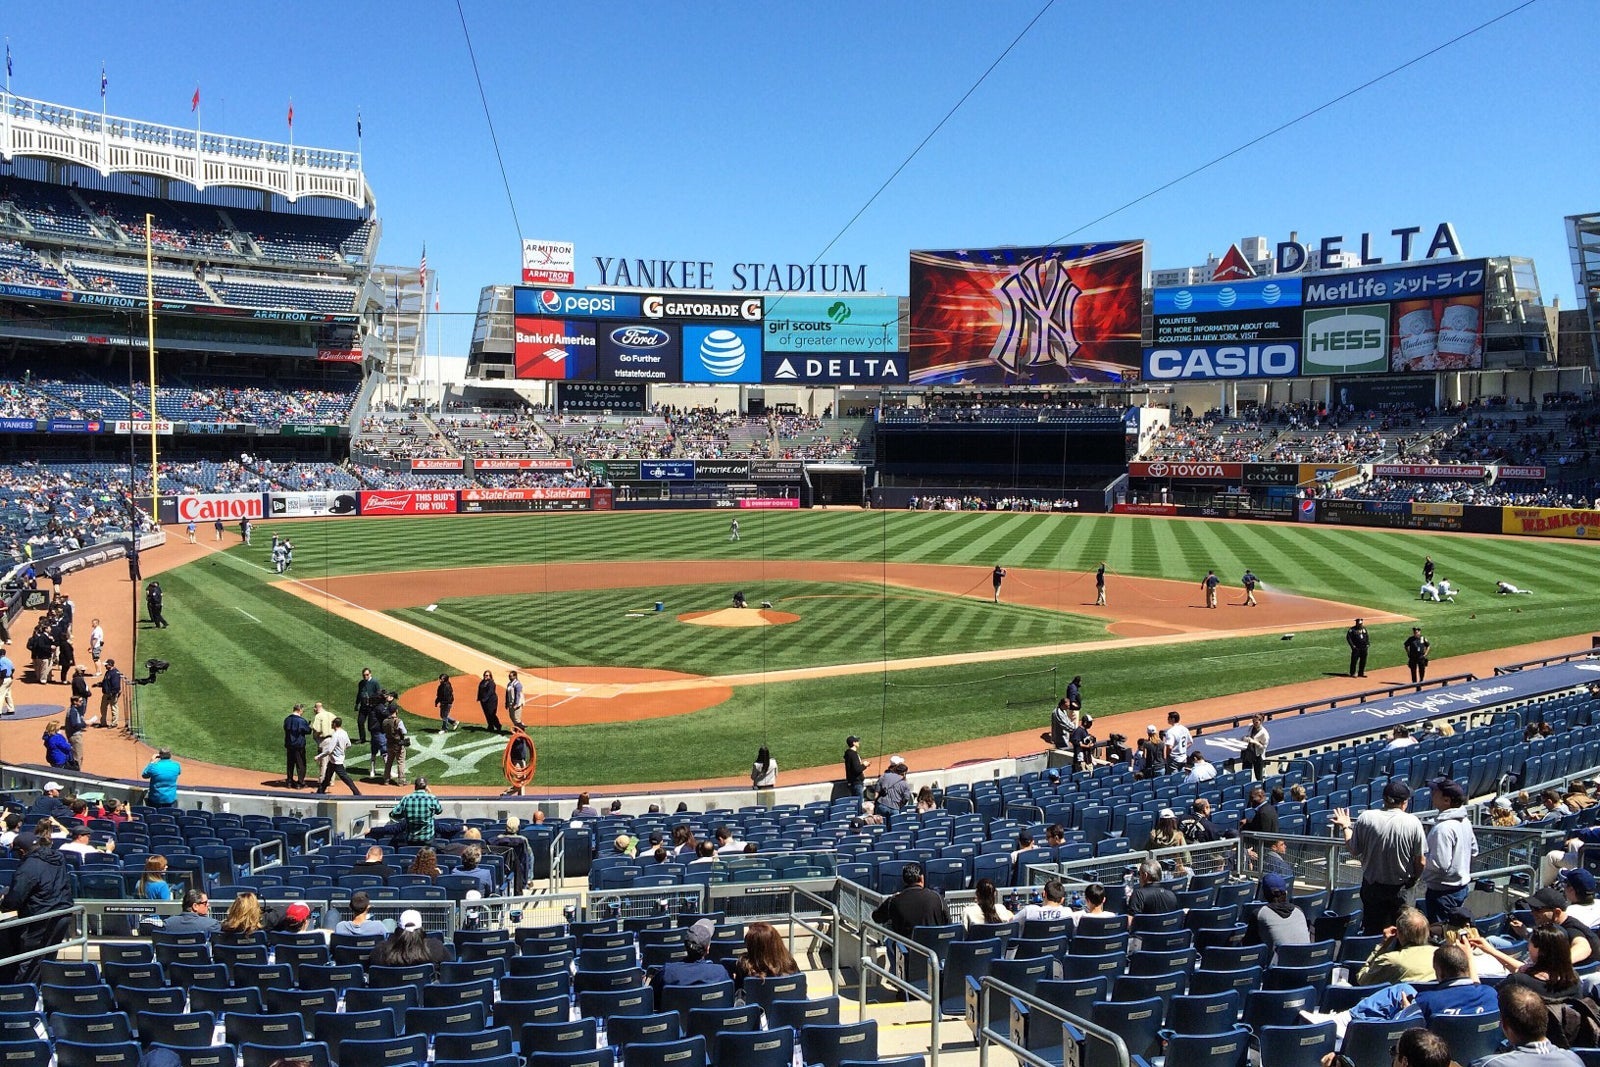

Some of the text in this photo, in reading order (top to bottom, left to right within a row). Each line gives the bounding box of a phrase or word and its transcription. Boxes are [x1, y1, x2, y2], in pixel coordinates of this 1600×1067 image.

[525, 244, 571, 254] ARMITRON
[1276, 222, 1465, 274] DELTA
[528, 270, 570, 280] ARMITRON
[592, 256, 868, 293] YANKEE STADIUM
[1393, 270, 1484, 295] メットライフ
[7, 286, 41, 297] YANKEES
[1306, 277, 1387, 303] MetLife
[79, 294, 135, 307] ARMITRON
[565, 295, 616, 314] pepsi
[254, 310, 307, 321] ARMITRON
[665, 303, 739, 317] GATORADE
[769, 318, 832, 334] girl scouts
[1159, 321, 1281, 335] FOR MORE INFORMATION ABOUT GIRL
[516, 332, 596, 346] Bank of America
[622, 328, 658, 345] Ford
[779, 333, 894, 348] of greater new york
[1158, 335, 1192, 343] SCOUTING
[1311, 329, 1381, 352] HESS
[319, 350, 362, 361] Budweiser
[619, 354, 661, 363] Go Further
[1149, 345, 1296, 379] CASIO
[806, 359, 899, 377] DELTA
[614, 369, 666, 379] tristateford.com
[2, 421, 33, 429] YANKEES
[119, 422, 169, 430] RUTGERS
[1170, 465, 1224, 476] TOYOTA
[1315, 471, 1336, 480] SAP
[1376, 466, 1481, 477] MODELL'S MODELLS.com
[1502, 469, 1541, 477] MODELL'S
[1247, 473, 1294, 481] COACH
[1227, 486, 1248, 494] FedEx
[367, 497, 403, 507] Budweiser
[414, 493, 455, 501] THIS BUD'S
[179, 497, 263, 520] Canon
[414, 502, 448, 511] FOR YOU.
[1382, 502, 1403, 511] pepsi
[1181, 737, 1187, 748] 2
